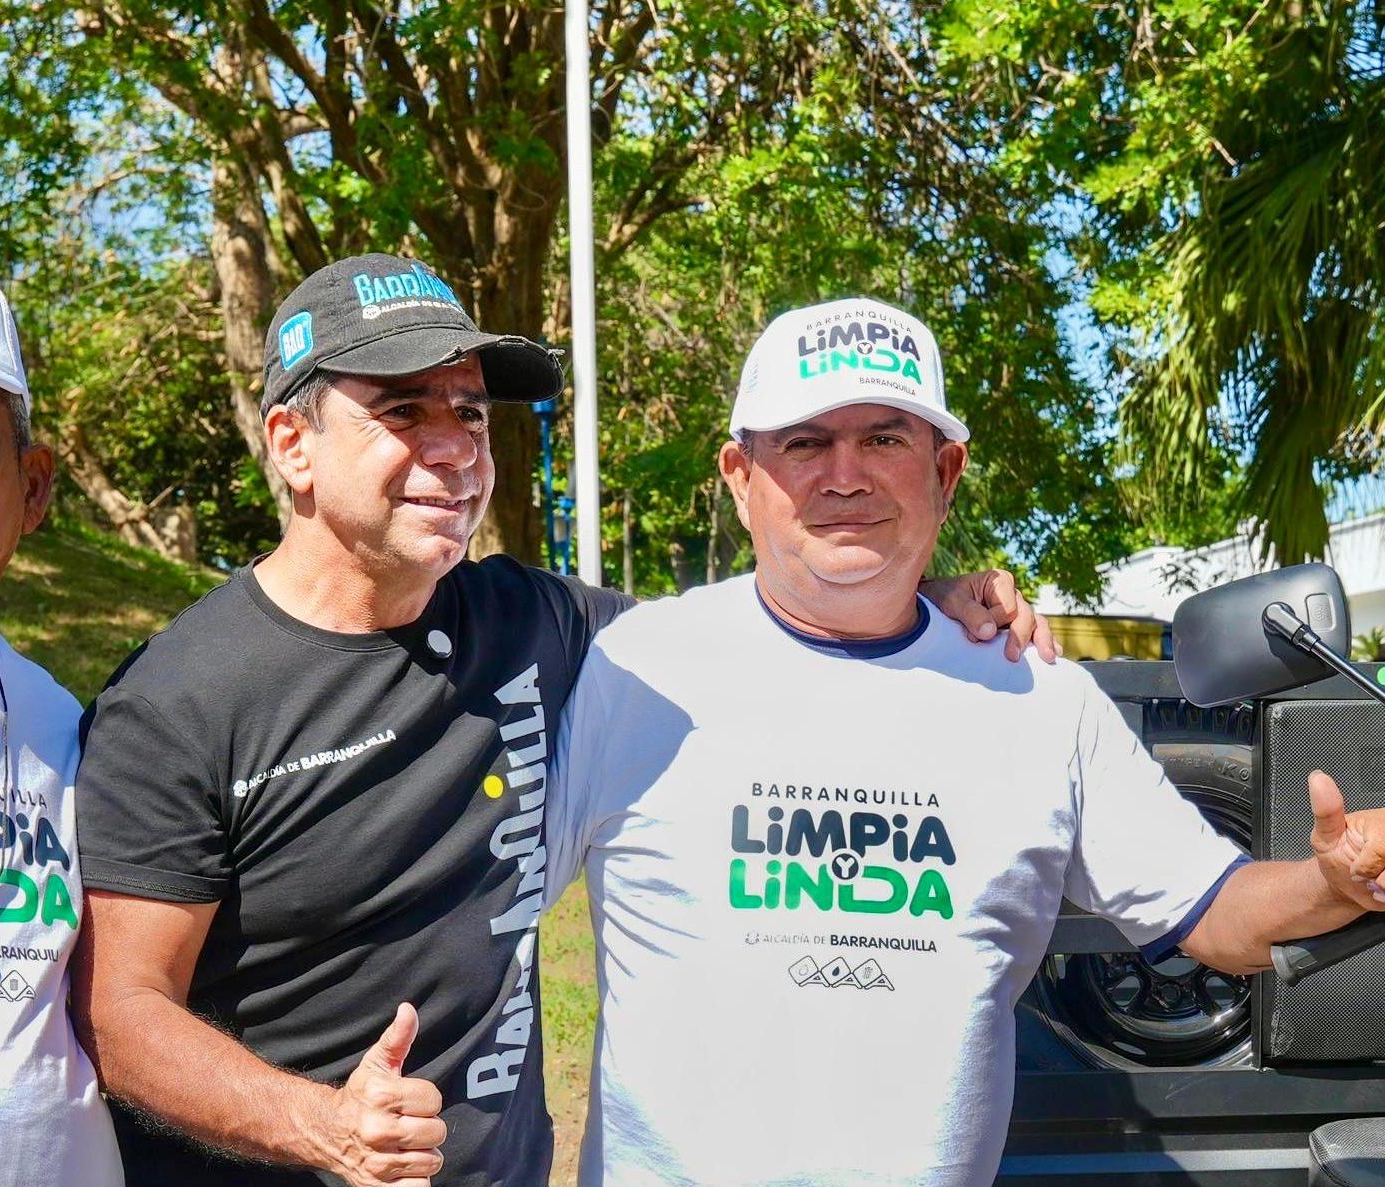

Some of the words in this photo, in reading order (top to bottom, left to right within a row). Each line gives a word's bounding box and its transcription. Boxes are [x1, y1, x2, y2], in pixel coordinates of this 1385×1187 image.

[806, 310, 912, 333] BARRANQUILLA
[859, 376, 916, 396] BARRANQUILLA
[287, 760, 301, 773] DE
[300, 729, 397, 770] BARRANQUILLA
[751, 782, 940, 808] BARRANQUILLA
[829, 934, 937, 953] BARRANQUILLA
